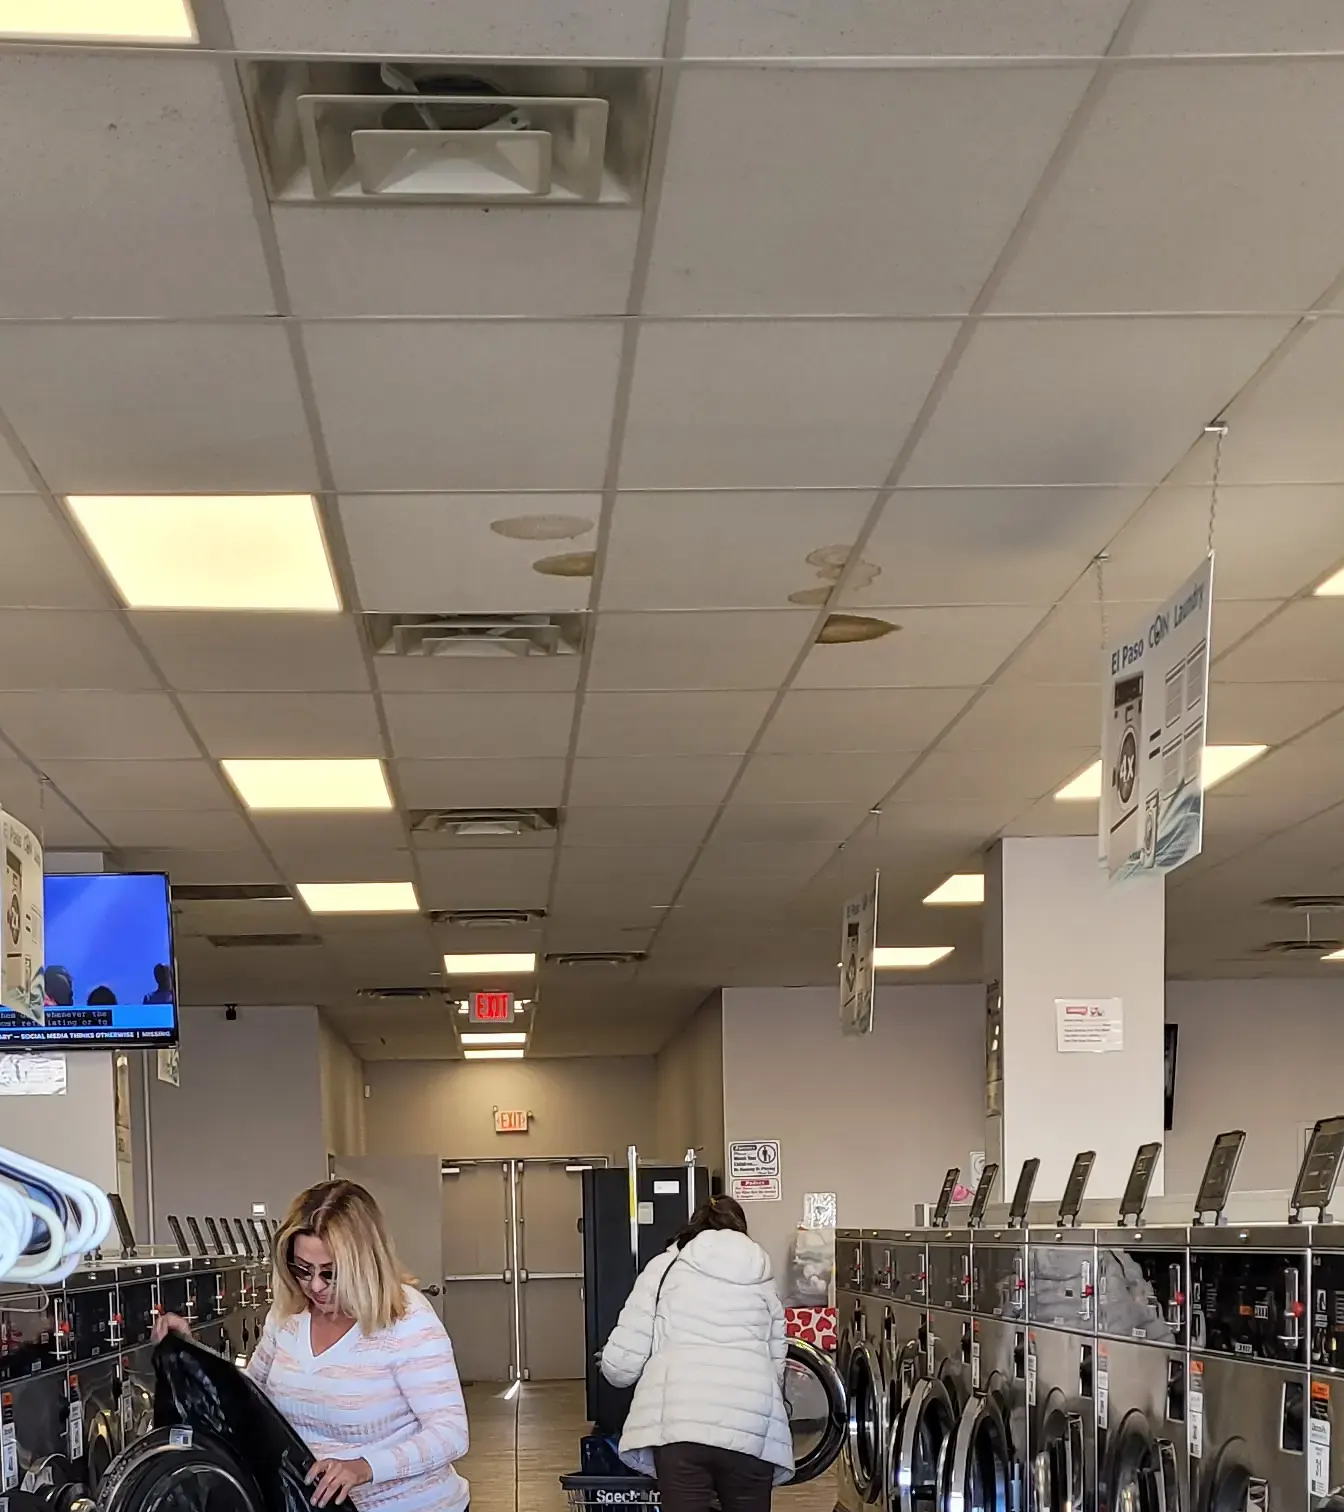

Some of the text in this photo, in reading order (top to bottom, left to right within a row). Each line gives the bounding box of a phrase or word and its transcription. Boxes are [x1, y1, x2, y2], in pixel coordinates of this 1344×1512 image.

[1112, 651, 1120, 676] El
[1122, 639, 1144, 669] Paso
[1173, 582, 1204, 629] Laundry
[476, 994, 509, 1019] EXIT
[500, 1111, 523, 1129] EXIT
